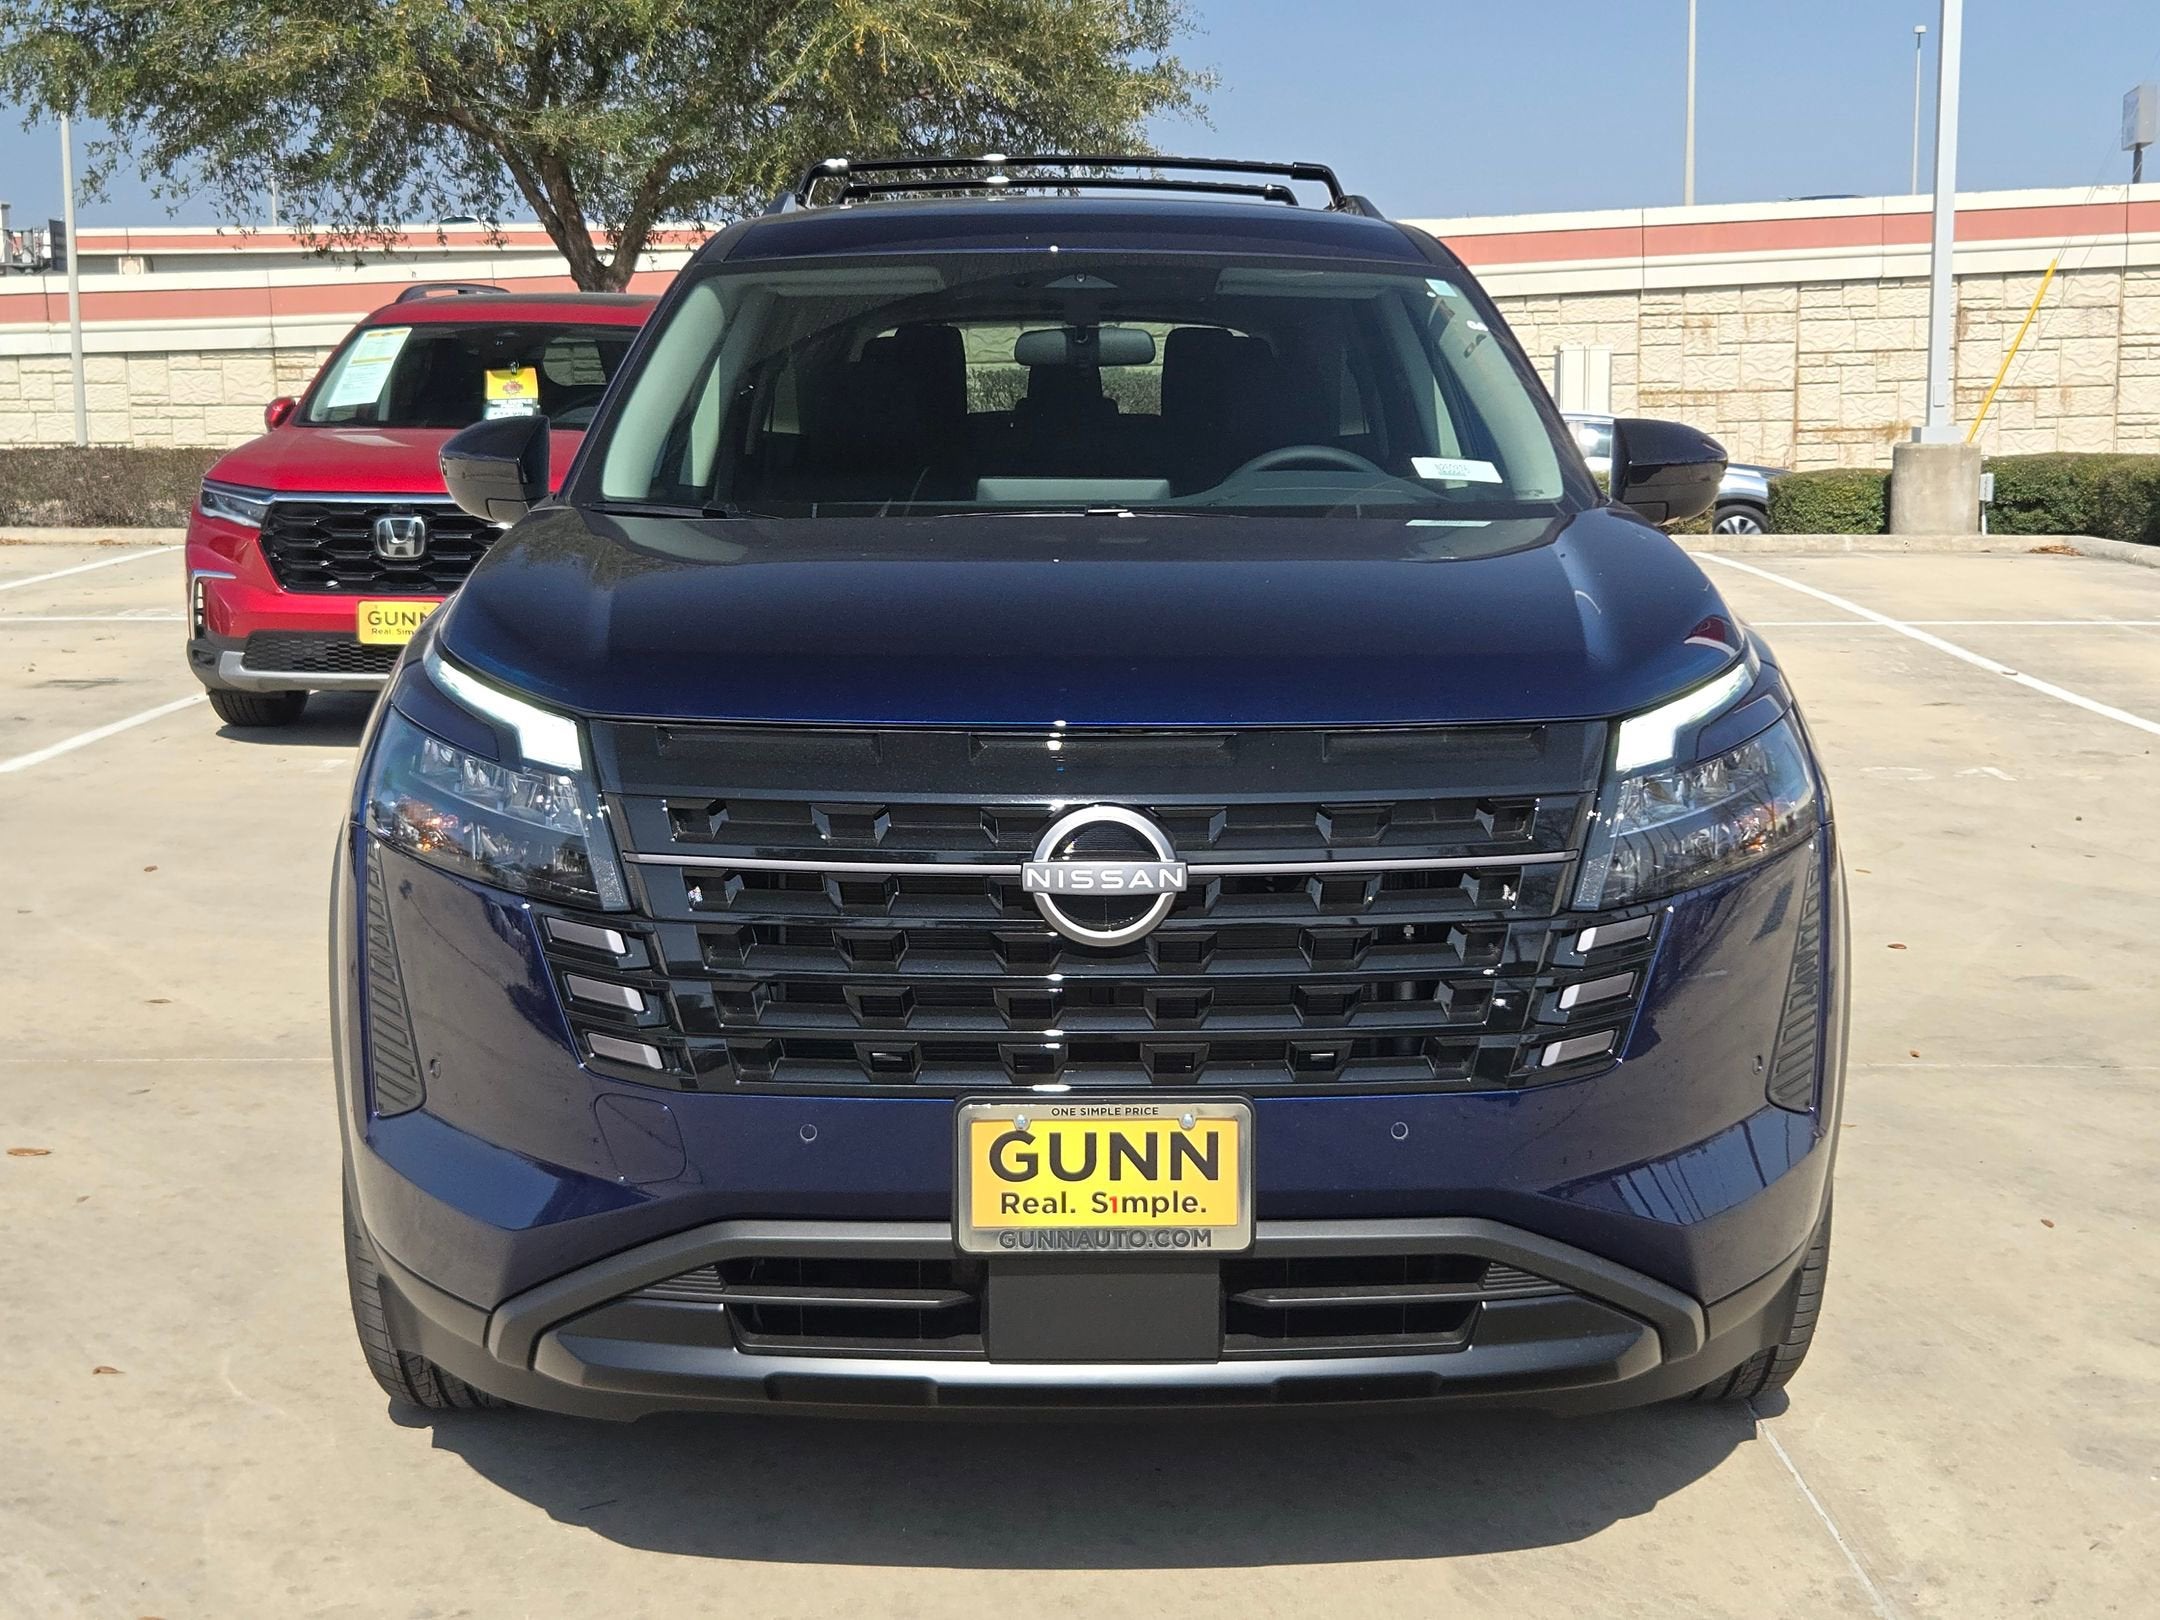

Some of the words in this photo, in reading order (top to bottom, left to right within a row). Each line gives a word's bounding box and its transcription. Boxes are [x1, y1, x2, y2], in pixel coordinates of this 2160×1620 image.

[1026, 868, 1183, 889] NISSAN
[1051, 1107, 1076, 1116] ONE
[1080, 1107, 1121, 1116] SIMPLE
[1125, 1107, 1159, 1116] PRICE
[989, 1129, 1219, 1182] GUNN
[1001, 1192, 1076, 1214] Real.
[1000, 1229, 1212, 1249] GUNNAUTO.COM
